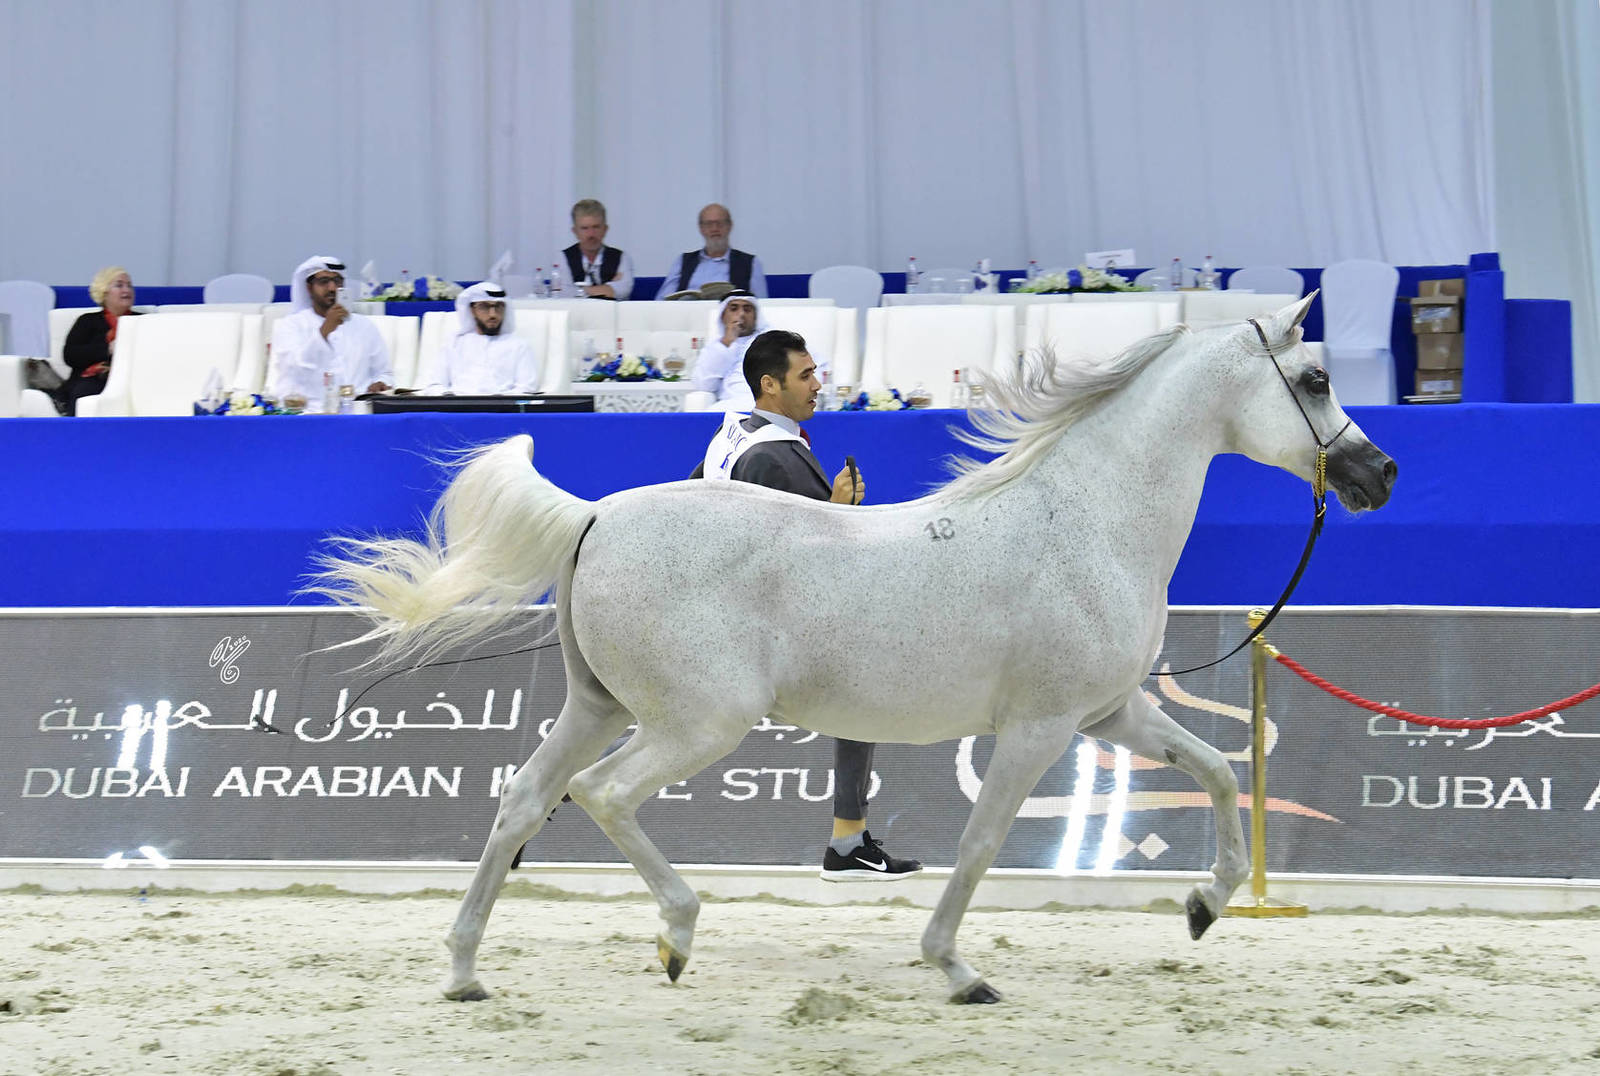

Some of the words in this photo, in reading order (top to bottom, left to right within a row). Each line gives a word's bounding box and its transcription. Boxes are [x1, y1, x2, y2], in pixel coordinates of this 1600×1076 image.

[923, 517, 955, 542] 18
[294, 687, 522, 742] للخيول
[21, 766, 191, 799] DUBAI
[212, 766, 464, 798] ARABIAN
[1361, 775, 1552, 810] DUBAI
